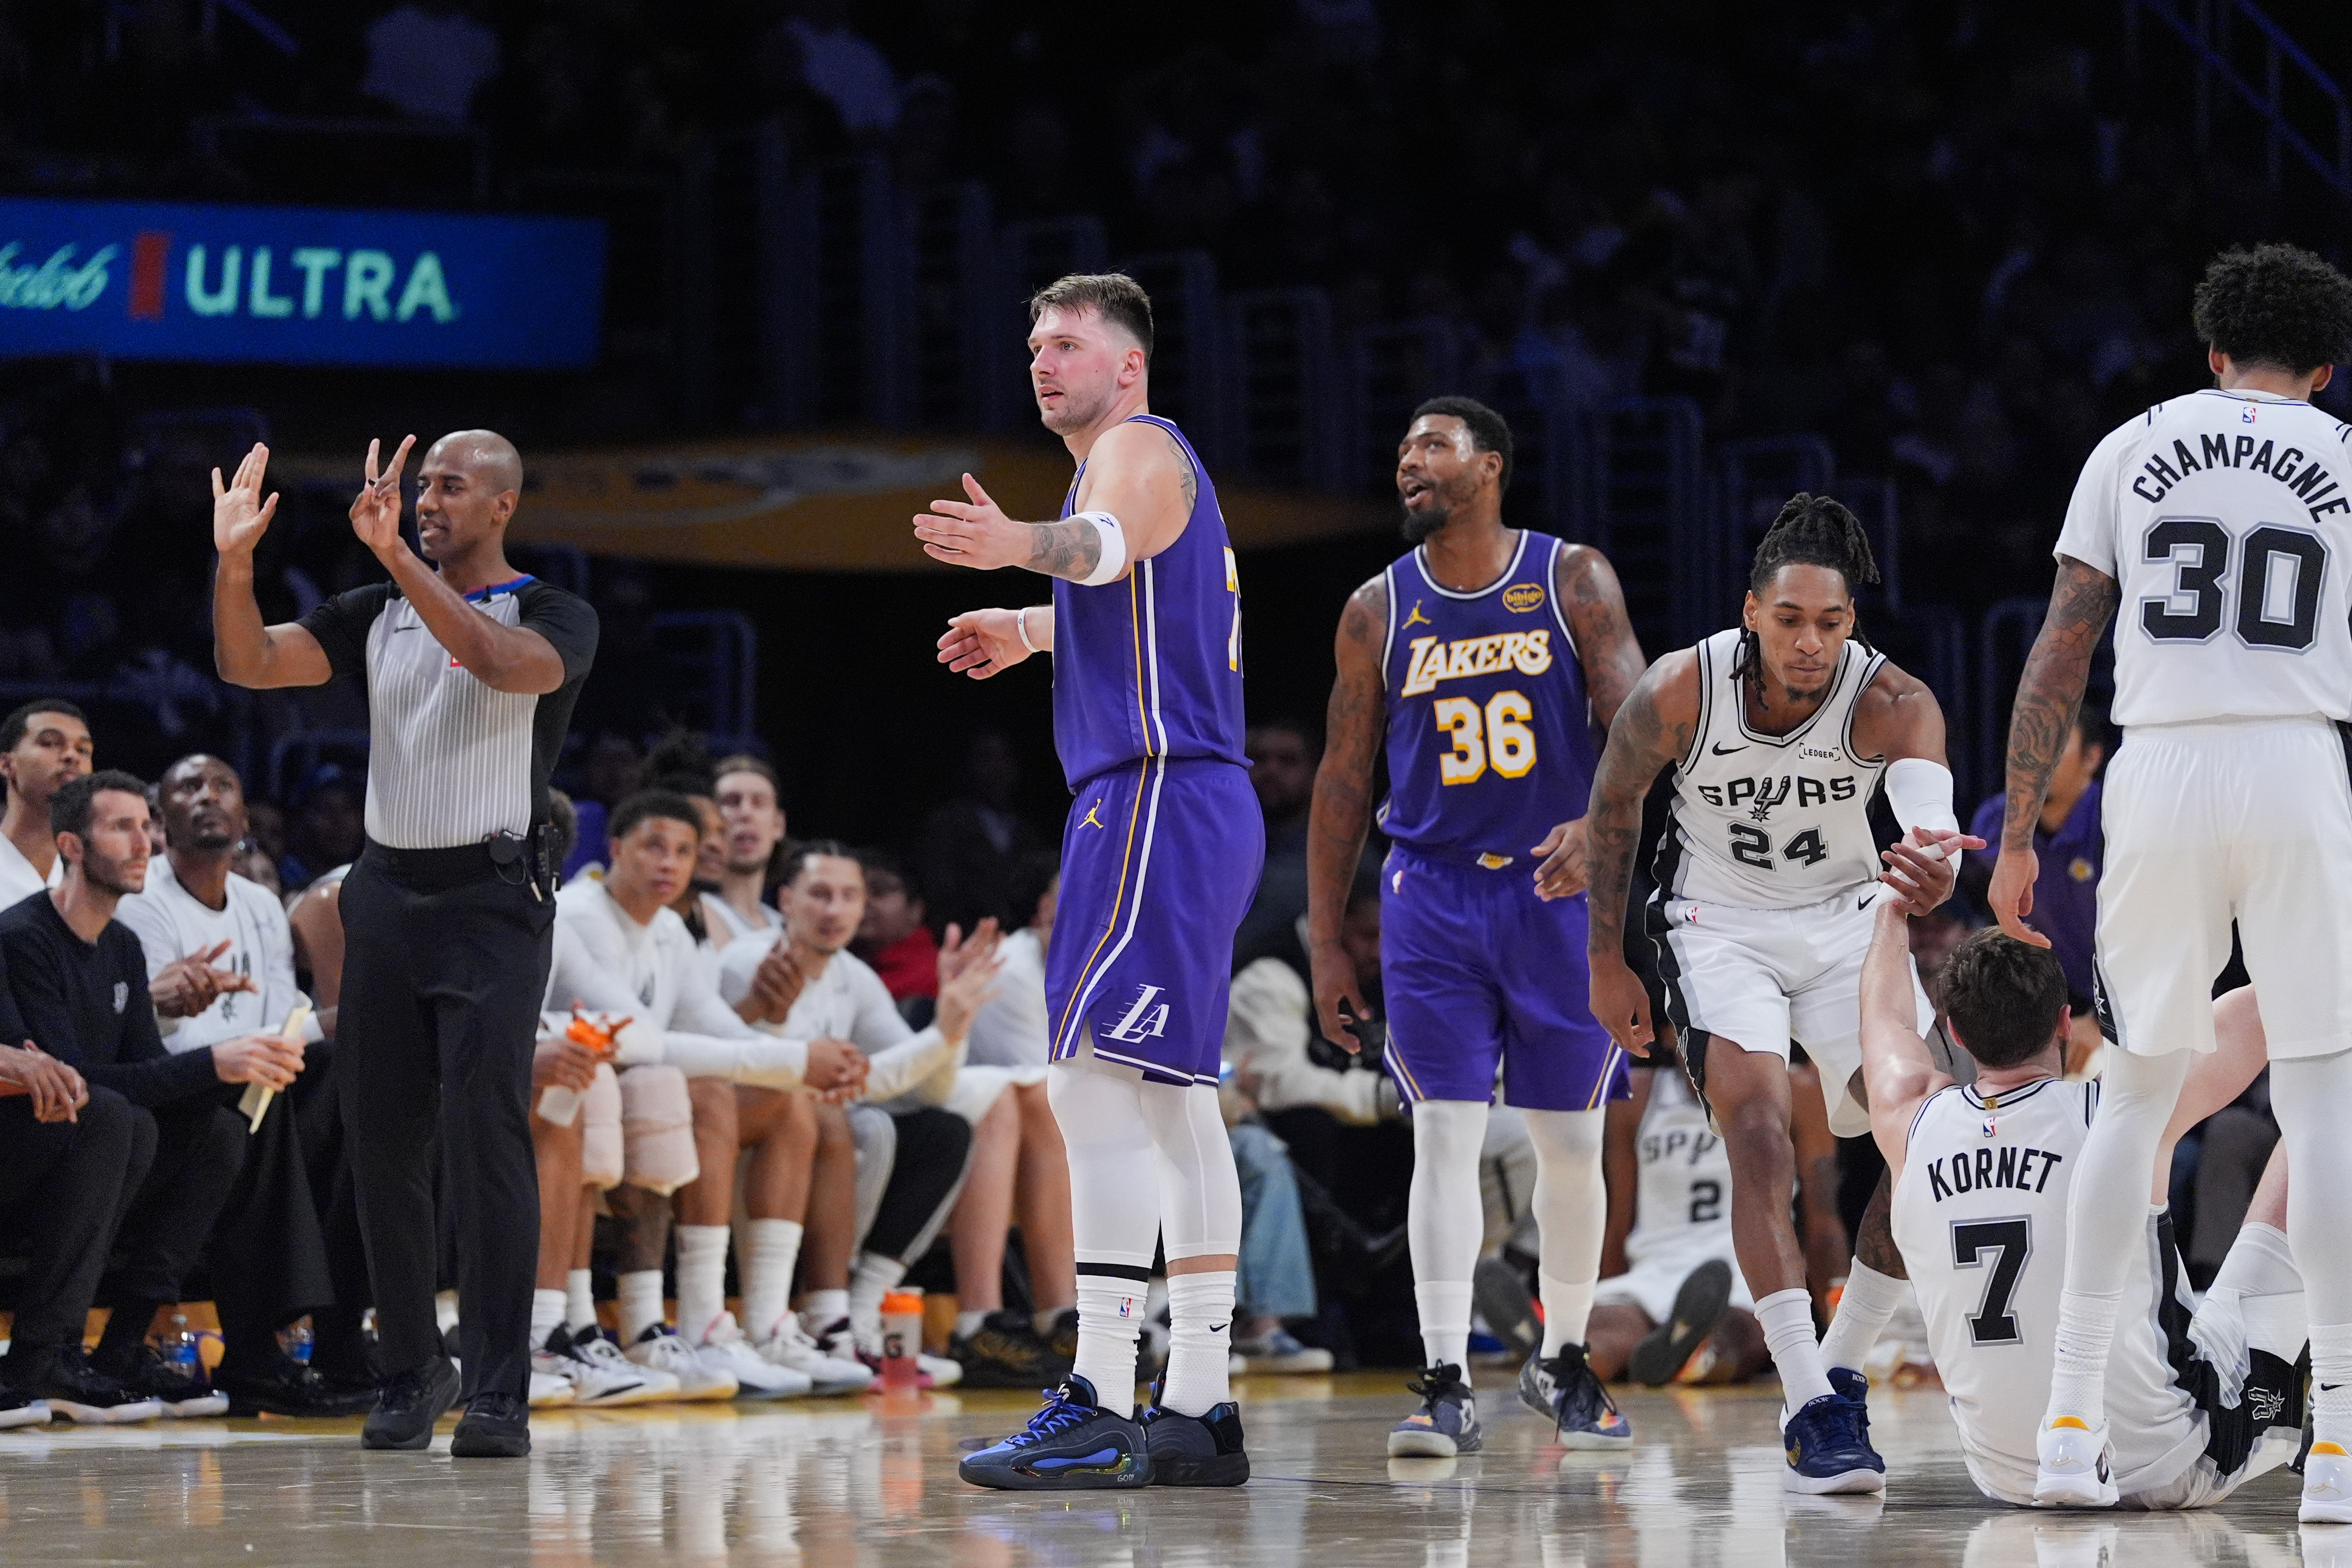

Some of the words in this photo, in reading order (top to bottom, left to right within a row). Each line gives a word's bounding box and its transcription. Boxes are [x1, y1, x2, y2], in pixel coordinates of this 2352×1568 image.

[186, 243, 457, 323] ULTRA
[2132, 433, 2351, 524] CHAMPAGNIE
[2139, 515, 2331, 656] 30
[1433, 690, 1537, 786] 36
[1803, 748, 1834, 758] LEDGER
[1698, 775, 1856, 823] SPURS
[1727, 820, 1830, 872] 24
[1689, 1179, 1721, 1222] 2
[1927, 1147, 2062, 1202] KORNET
[1949, 1214, 2033, 1347] 7
[1808, 1396, 1831, 1407] BOOK
